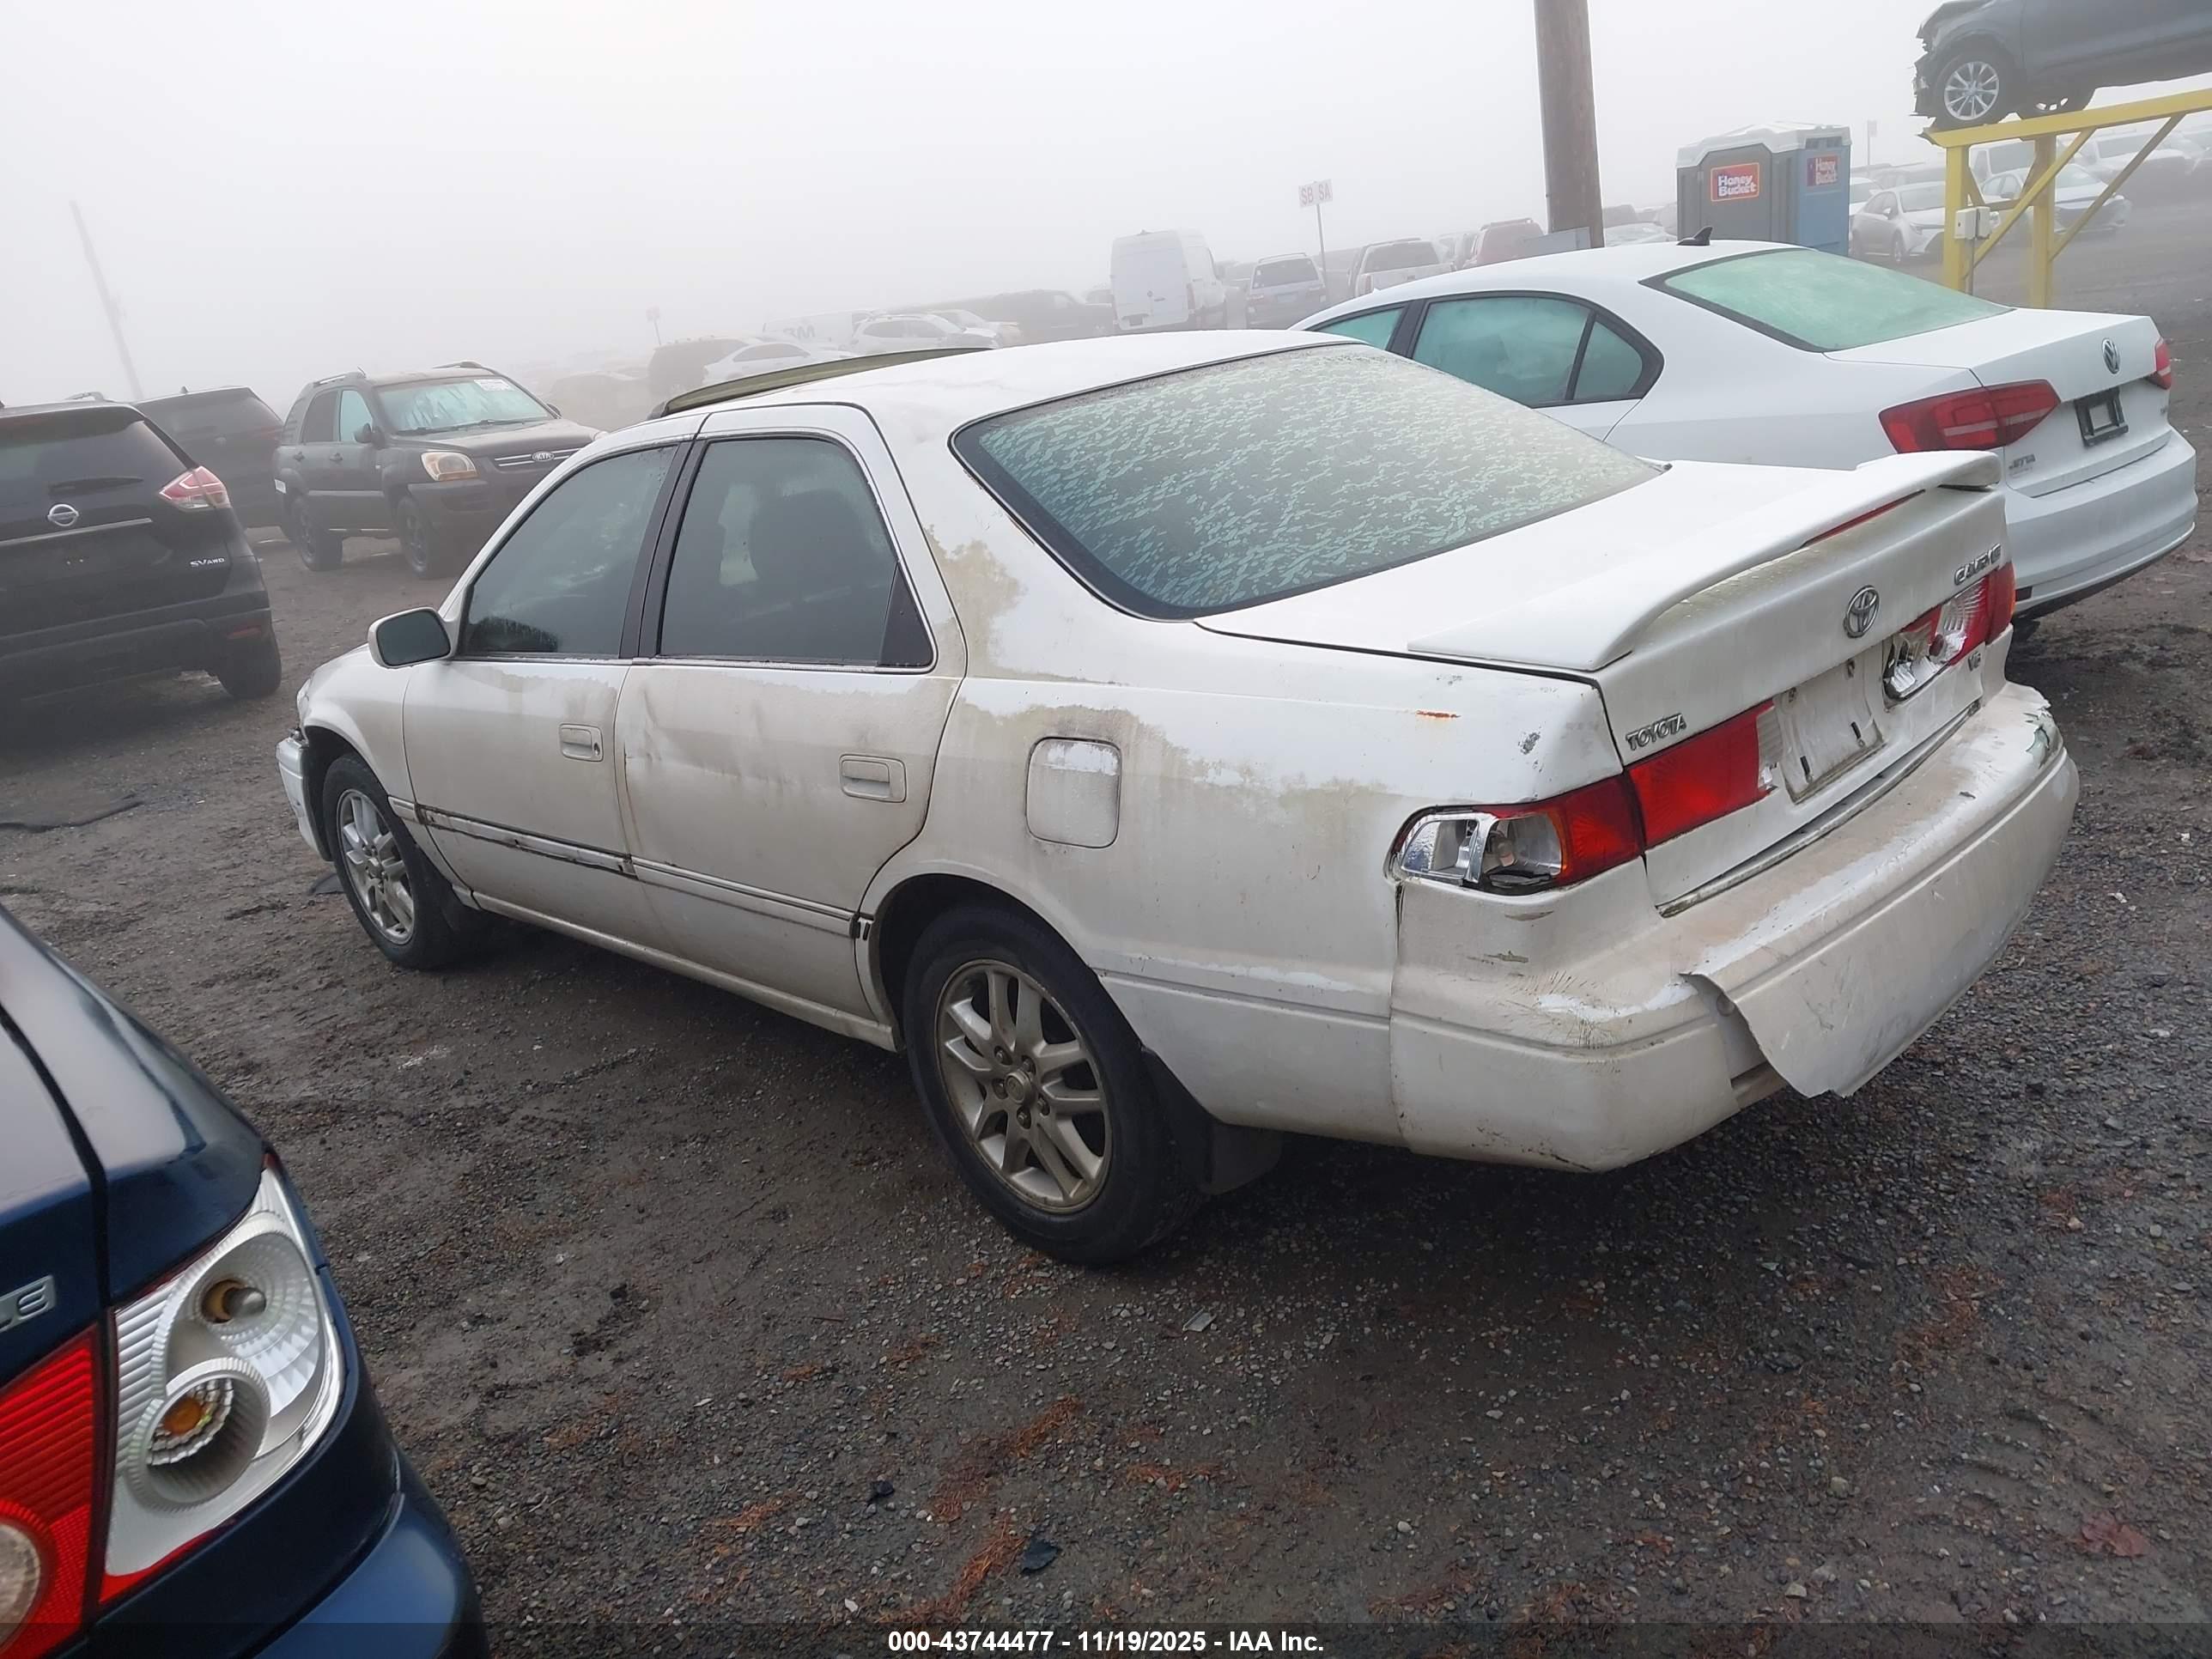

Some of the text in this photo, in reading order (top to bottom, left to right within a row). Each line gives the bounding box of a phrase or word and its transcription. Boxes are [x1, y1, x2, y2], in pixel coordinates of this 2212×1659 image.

[1717, 174, 1753, 187] Honey
[1717, 182, 1757, 197] Bucket
[1301, 183, 1331, 205] SB SA
[1625, 712, 1687, 751] TOYOTA
